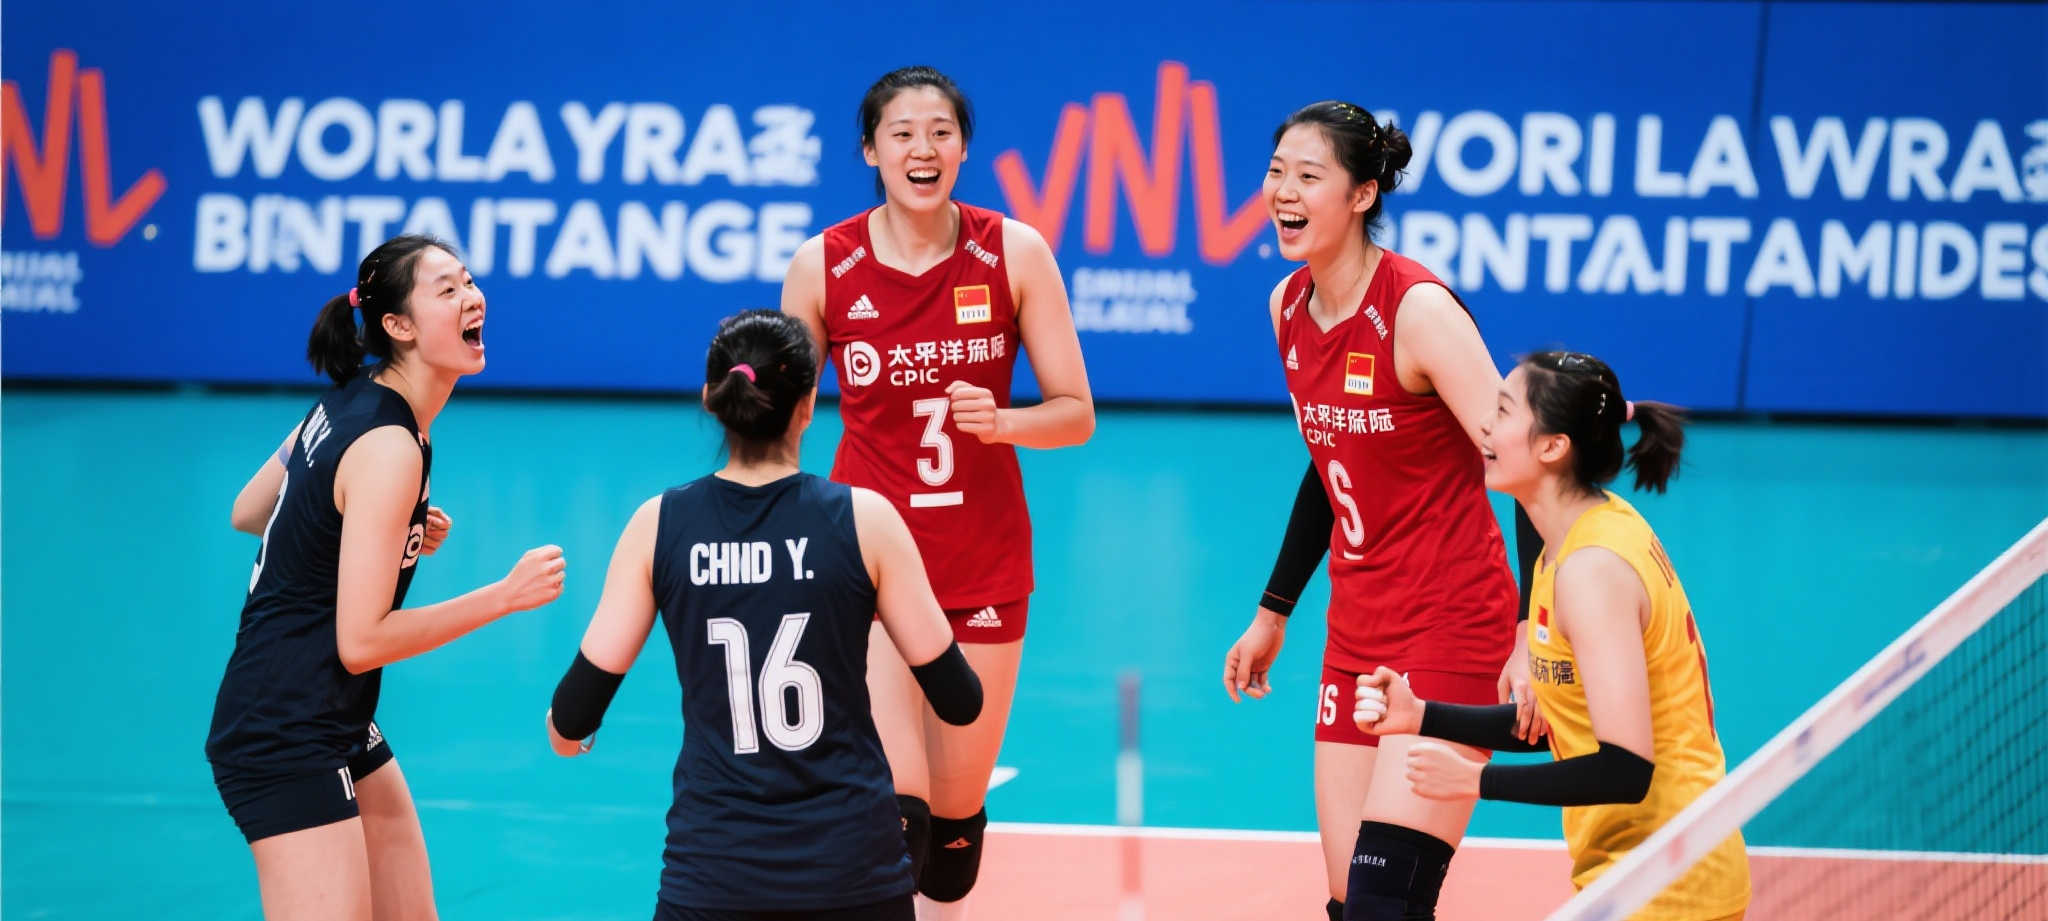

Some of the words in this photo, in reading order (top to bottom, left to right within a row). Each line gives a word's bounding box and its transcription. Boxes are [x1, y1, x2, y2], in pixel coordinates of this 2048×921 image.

[890, 368, 941, 387] CPIC
[912, 397, 956, 487] 3
[784, 537, 815, 580] Y.
[707, 612, 825, 755] 16
